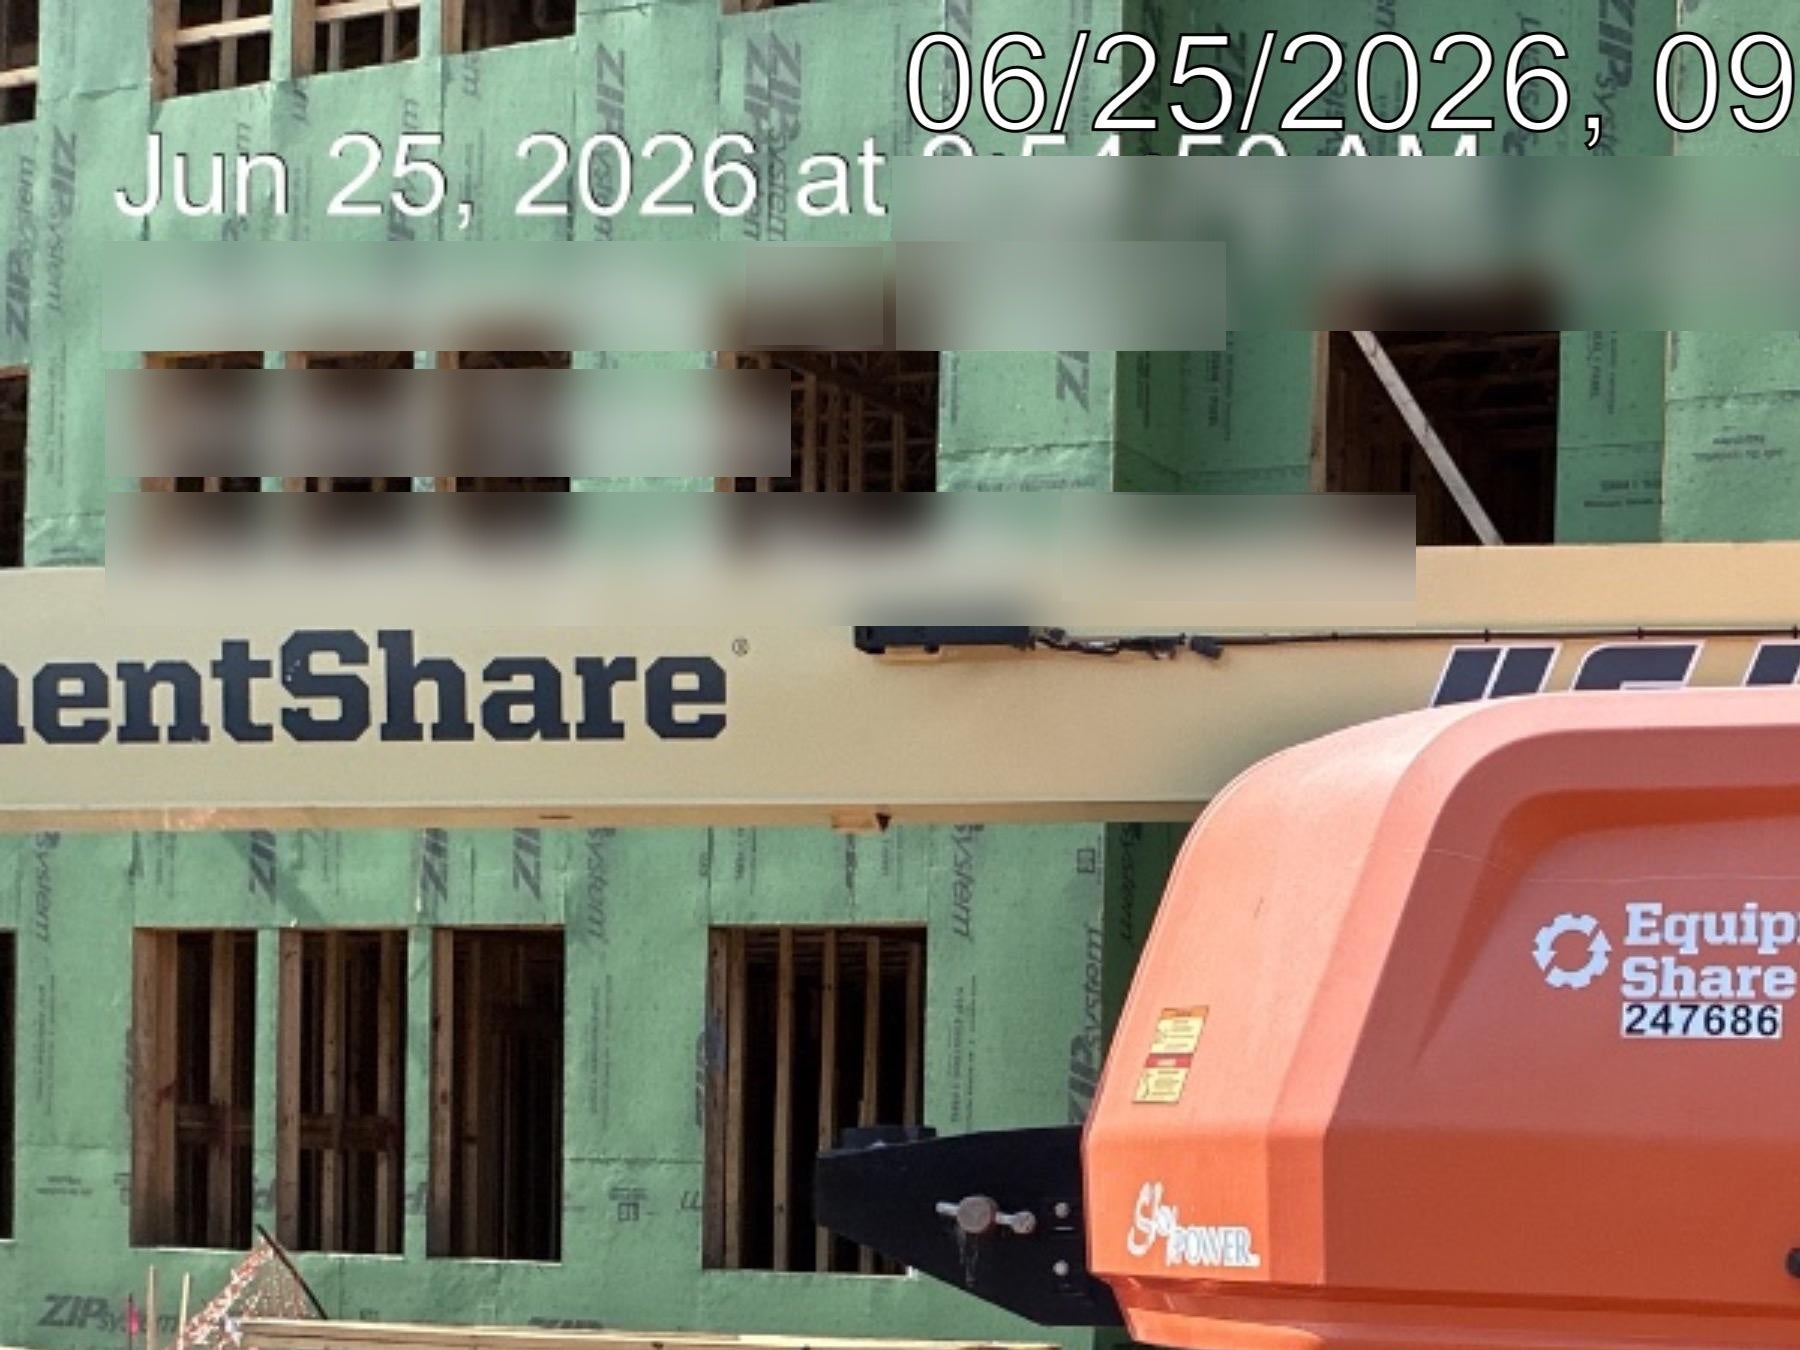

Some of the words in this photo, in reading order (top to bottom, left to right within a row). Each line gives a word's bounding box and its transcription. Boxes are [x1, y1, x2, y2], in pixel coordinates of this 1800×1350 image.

[1621, 957, 1797, 1000] Share
[1624, 1004, 1779, 1036] 247686
[1171, 1226, 1253, 1266] POWER
